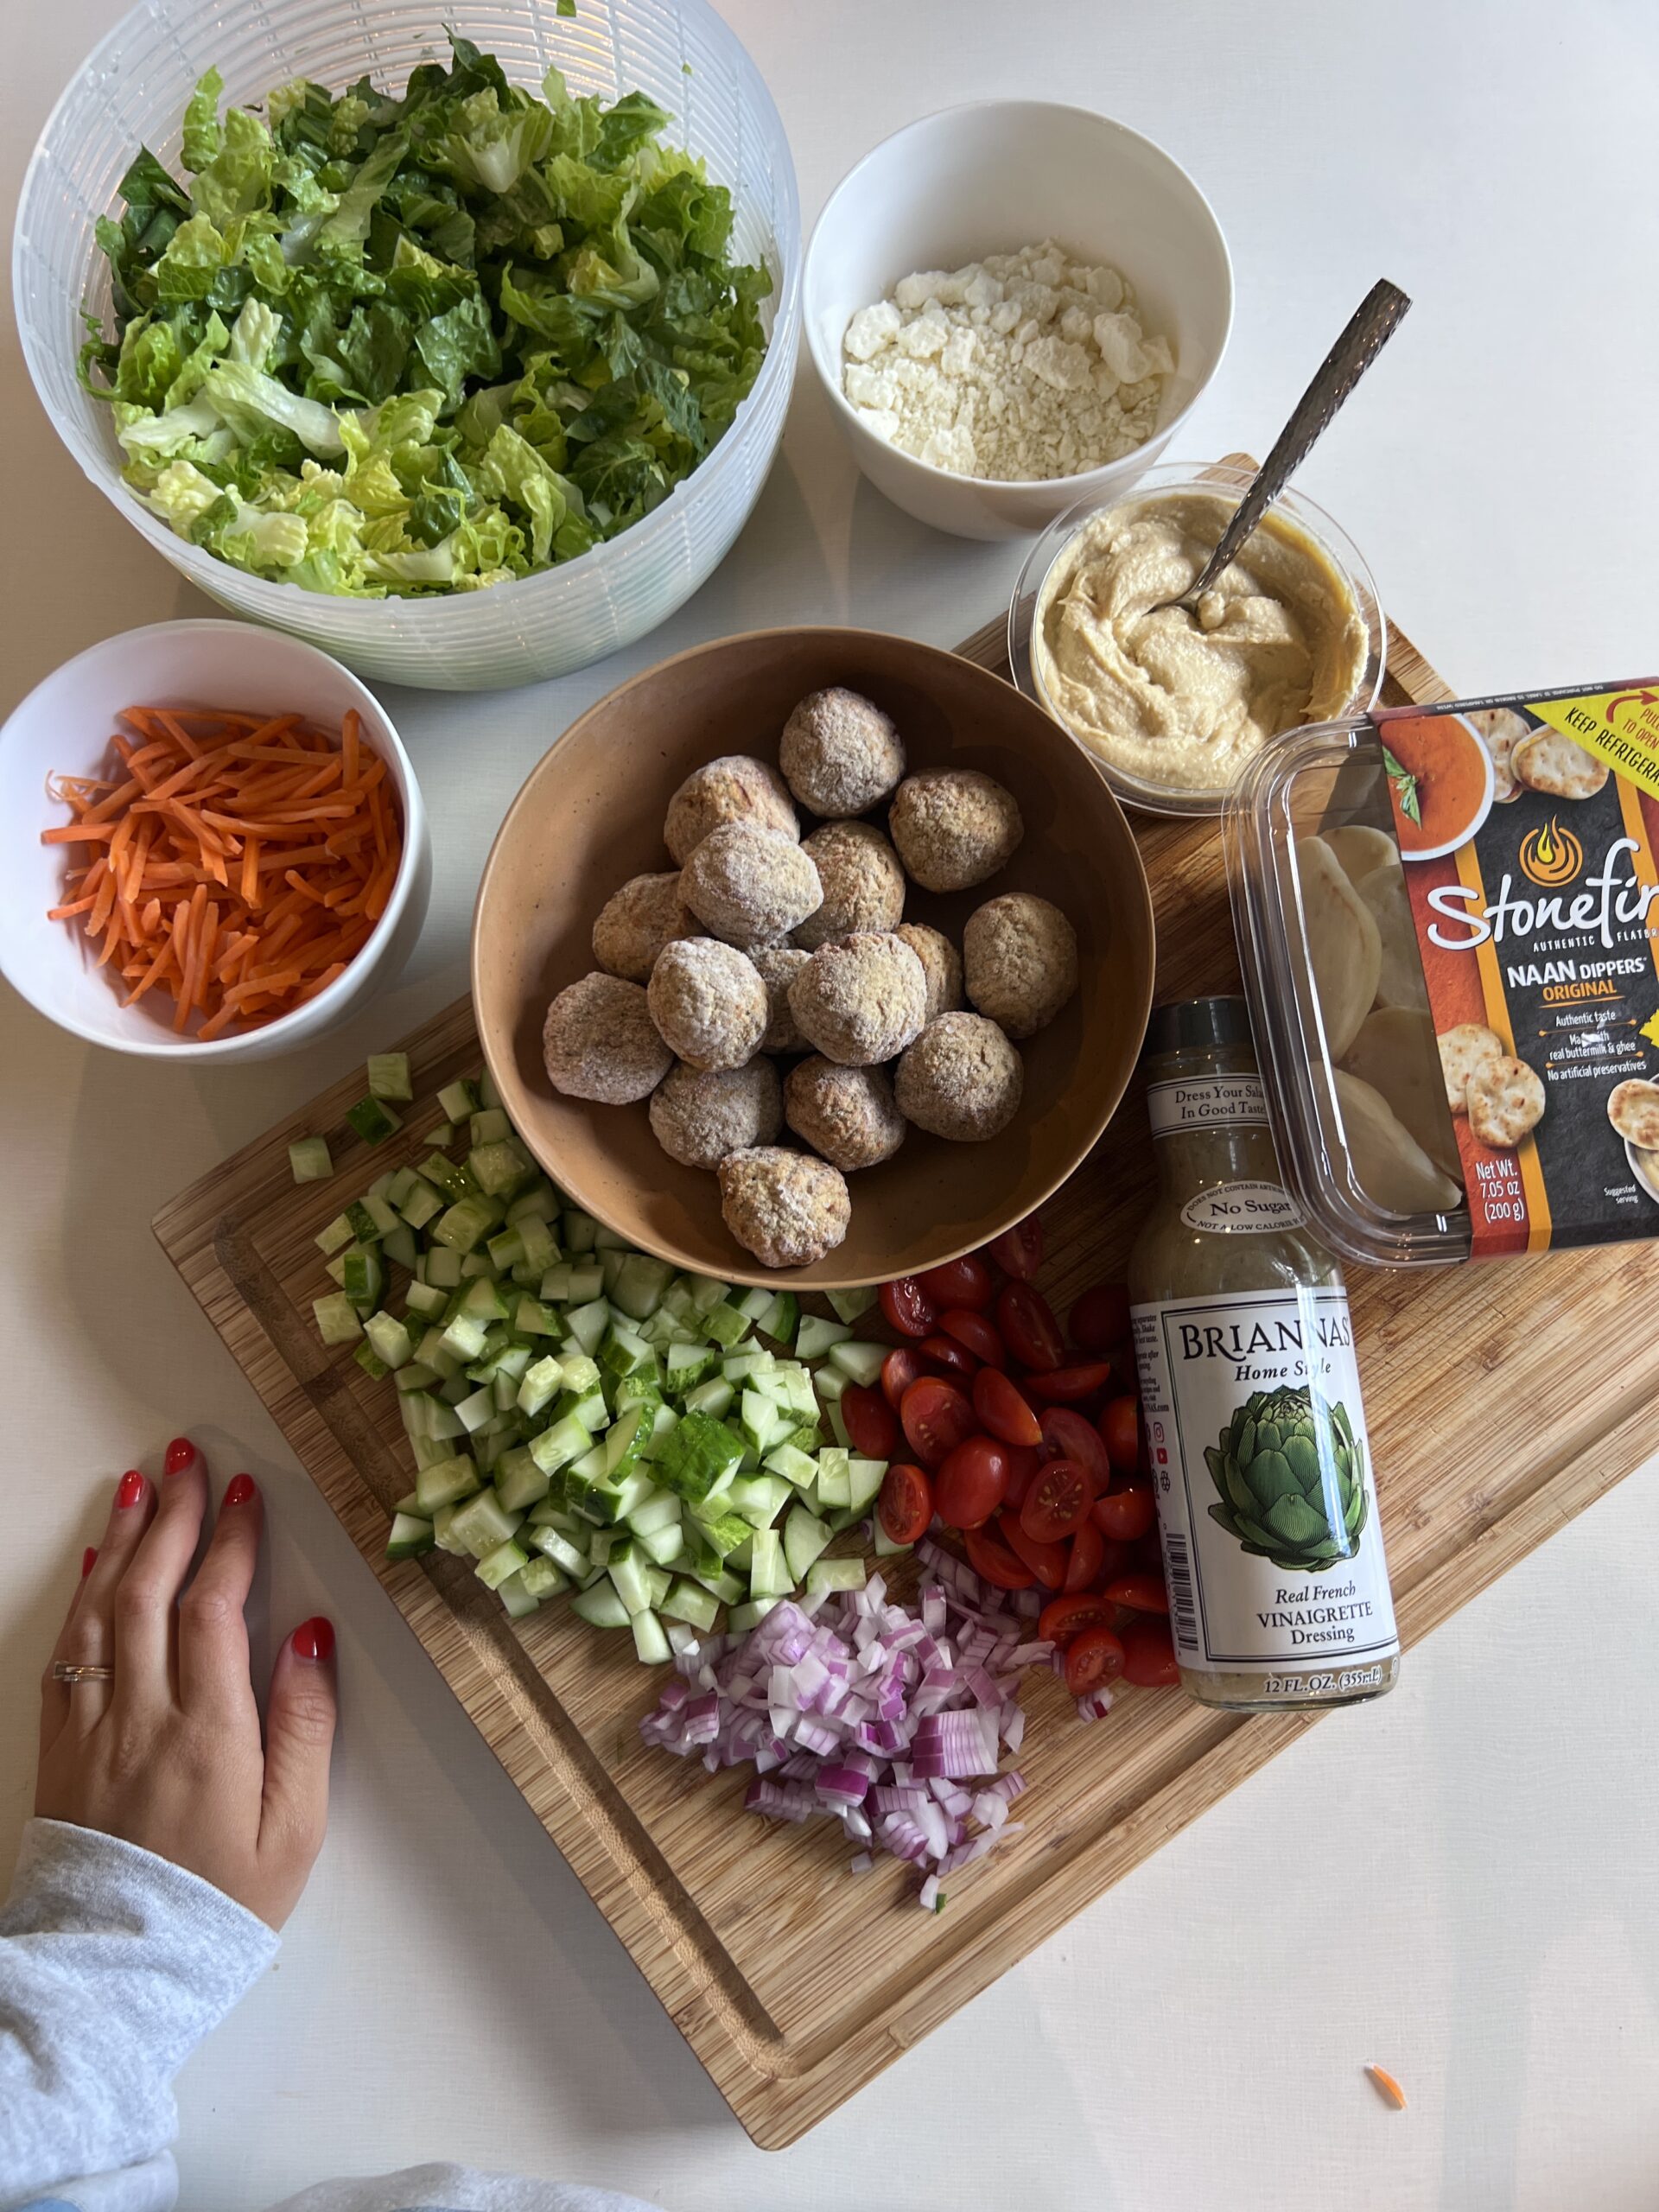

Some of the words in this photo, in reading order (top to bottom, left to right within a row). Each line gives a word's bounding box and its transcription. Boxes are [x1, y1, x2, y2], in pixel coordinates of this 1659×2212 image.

[1623, 718, 1637, 734] TO
[1636, 728, 1659, 750] OPEN
[1565, 707, 1597, 734] KEEP
[1595, 728, 1659, 786] REFRIGERA
[1533, 935, 1595, 952] AUTHENTIC
[1507, 959, 1576, 988] NAAN
[1580, 957, 1645, 979] DIPPERS
[1542, 979, 1618, 1001] ORIGINAL
[1555, 1012, 1593, 1027] Authentic
[1594, 1010, 1616, 1022] taste
[1549, 1048, 1566, 1061] real
[1566, 1044, 1606, 1059] buttermilk
[1607, 1042, 1615, 1054] &
[1616, 1040, 1636, 1055] ghee
[1548, 1070, 1560, 1081] No
[1560, 1065, 1592, 1079] artificial
[1593, 1060, 1647, 1078] preservatives
[1175, 1090, 1211, 1103] Dress
[1213, 1086, 1243, 1098] Your
[1181, 1106, 1195, 1119] In
[1198, 1103, 1236, 1116] Good
[1476, 1161, 1496, 1180] Net
[1496, 1159, 1518, 1178] Wt.
[1187, 1195, 1207, 1211] DOES
[1206, 1188, 1223, 1198] NOT
[1224, 1184, 1259, 1193] CONTAIN
[1479, 1180, 1503, 1198] 7.05
[1507, 1181, 1520, 1195] oz
[1604, 1184, 1636, 1197] Suggested
[1210, 1202, 1242, 1216] No
[1244, 1199, 1292, 1214] Sugar
[1484, 1202, 1510, 1224] (200
[1512, 1198, 1524, 1221] g)
[1197, 1221, 1218, 1230] NOT
[1255, 1220, 1294, 1230] CALORIE
[1235, 1365, 1287, 1382] Home
[1274, 1586, 1309, 1605] Real
[1313, 1580, 1356, 1600] French
[1256, 1601, 1373, 1628] VINAIGRETTE
[1291, 1625, 1355, 1644] Dressing
[1265, 1679, 1280, 1694] 12
[1339, 1666, 1382, 1690] (355mL)
